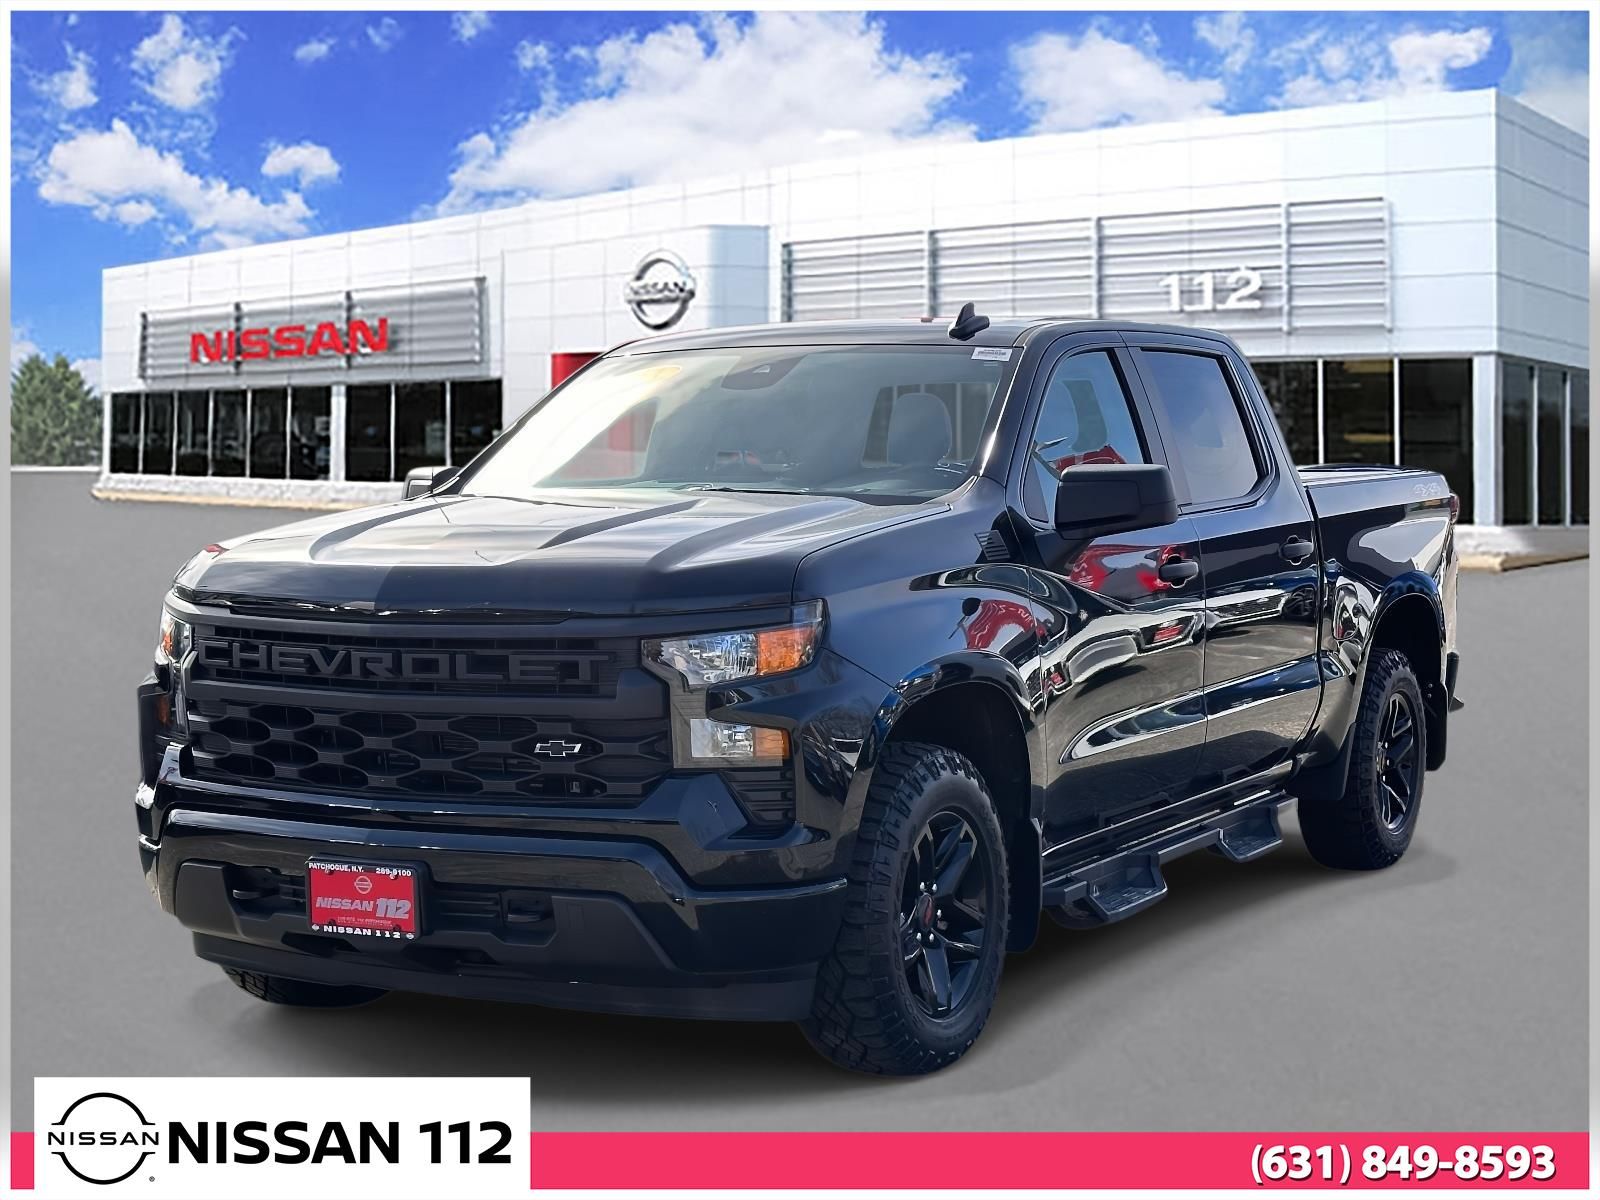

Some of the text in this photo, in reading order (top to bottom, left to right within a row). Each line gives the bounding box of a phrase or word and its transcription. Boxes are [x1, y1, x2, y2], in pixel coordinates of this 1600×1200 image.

[630, 280, 688, 301] NISSAN
[1159, 269, 1262, 311] 112
[190, 317, 388, 363] NISSAN
[199, 640, 609, 682] CHEVROLET
[308, 862, 350, 872] PATCHOGUE,
[316, 897, 411, 919] NISSAN 112
[323, 925, 372, 936] NISSAN
